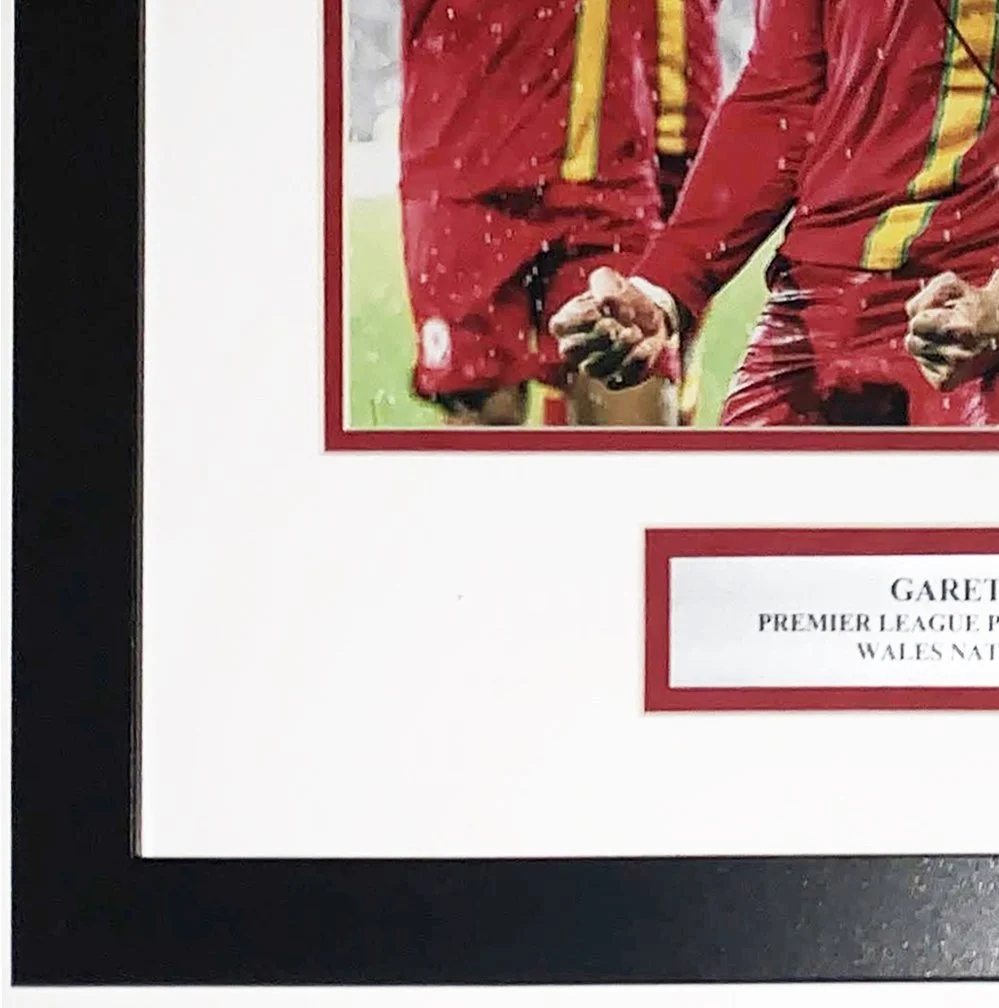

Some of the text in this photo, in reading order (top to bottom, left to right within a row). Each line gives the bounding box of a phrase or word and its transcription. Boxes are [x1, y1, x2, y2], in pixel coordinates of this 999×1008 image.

[758, 612, 871, 632] PREMIER
[879, 613, 980, 633] LEAGUE
[857, 642, 943, 660] WALES
